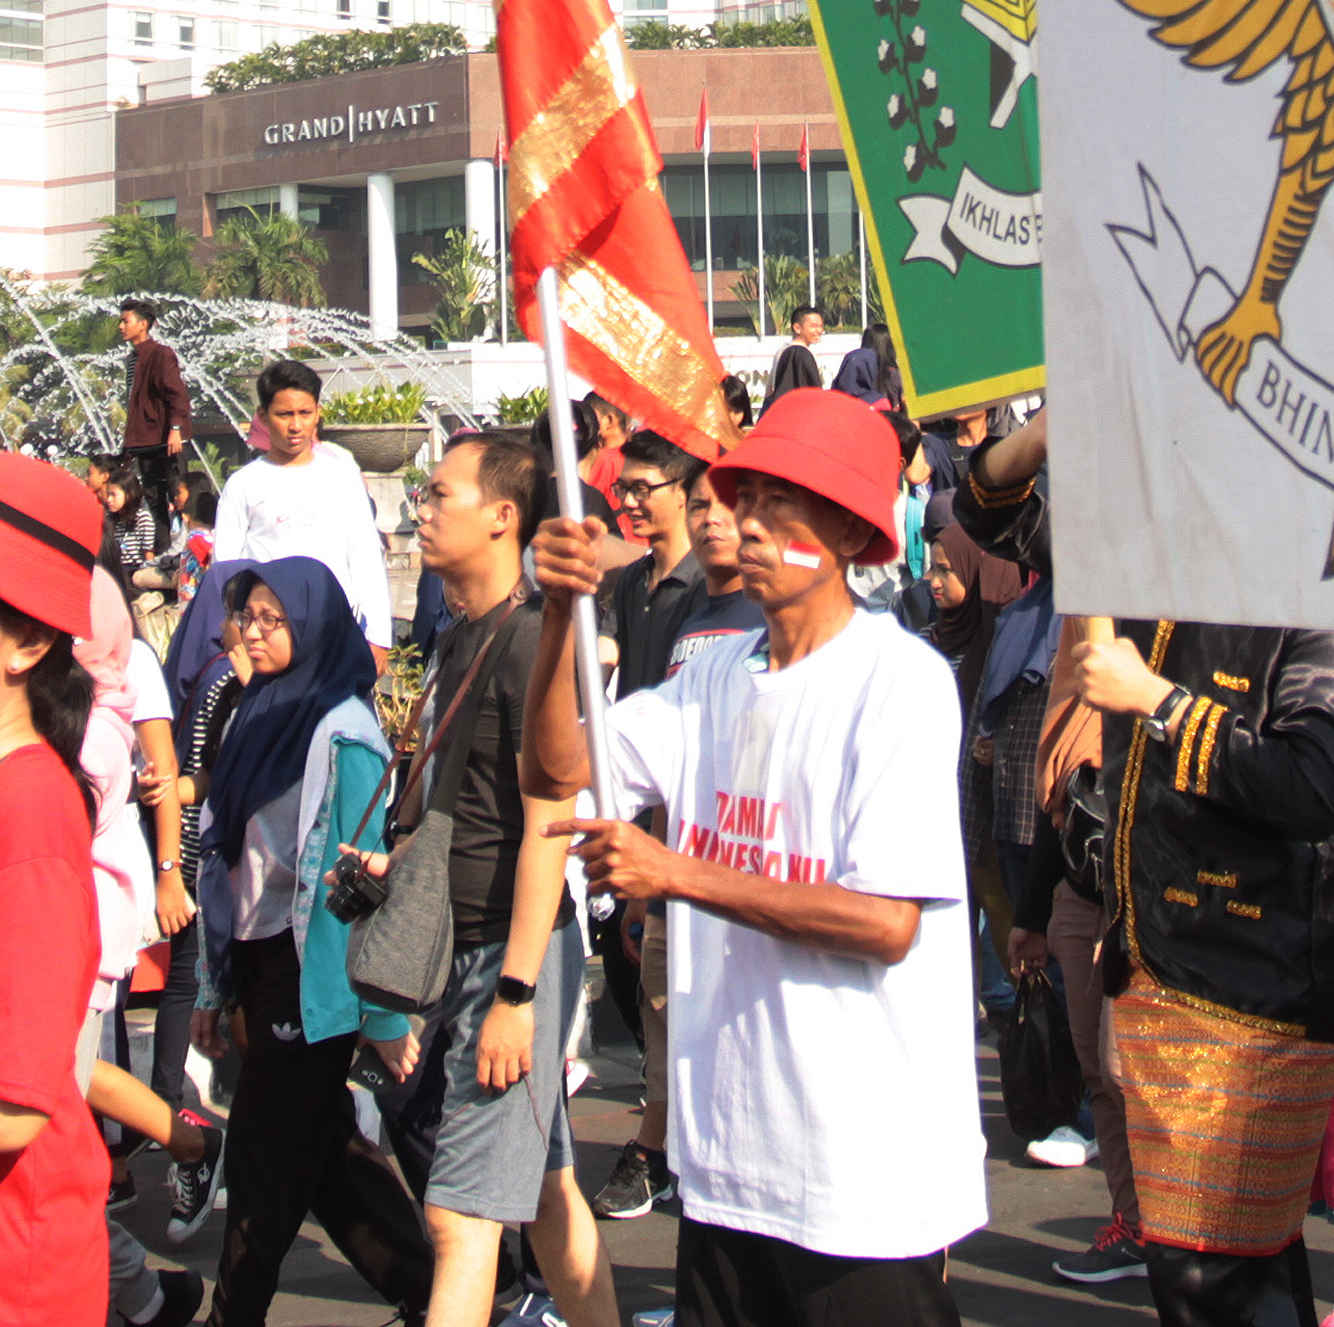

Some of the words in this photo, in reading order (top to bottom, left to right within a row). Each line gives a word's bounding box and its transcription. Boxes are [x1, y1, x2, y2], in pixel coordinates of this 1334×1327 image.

[264, 116, 344, 144] GRAND
[358, 102, 439, 132] HYATT
[959, 192, 1030, 246] IKHLAS
